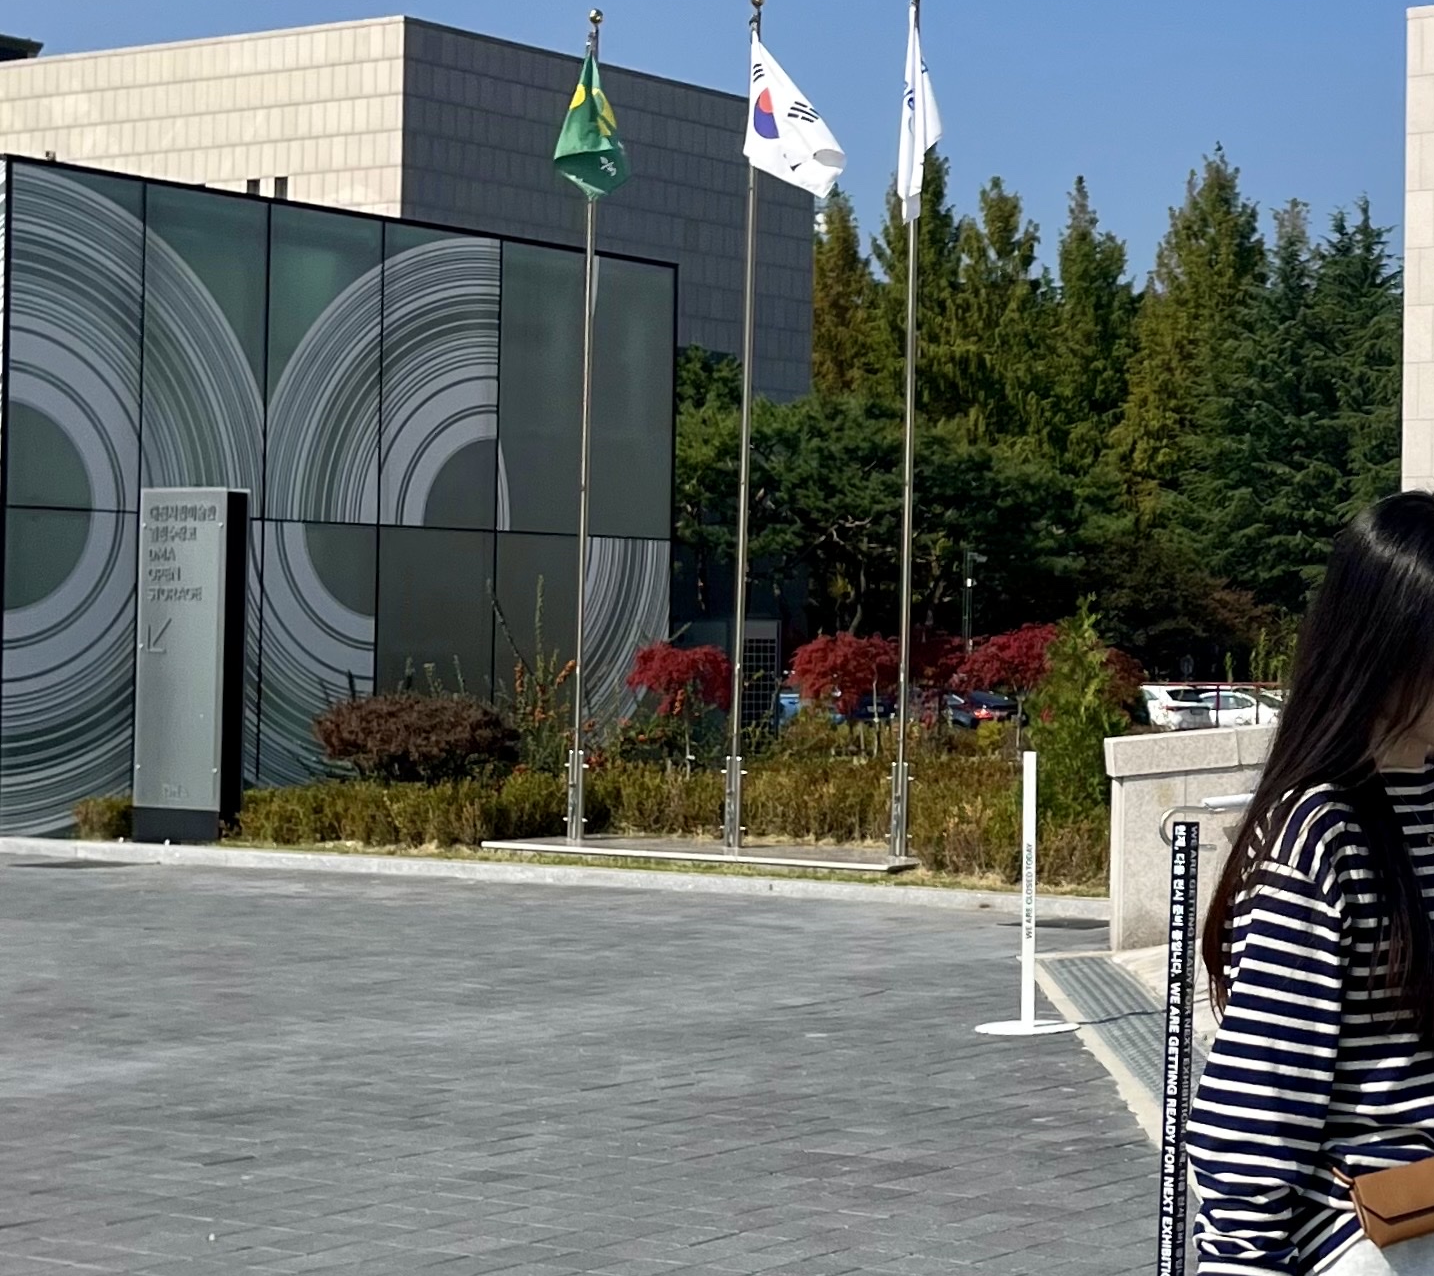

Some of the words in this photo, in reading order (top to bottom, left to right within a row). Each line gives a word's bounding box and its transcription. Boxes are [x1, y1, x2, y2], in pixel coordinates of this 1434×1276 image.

[1190, 825, 1198, 847] WE
[1026, 927, 1033, 940] WE
[1170, 982, 1182, 1005] WE
[1168, 1005, 1180, 1034] ARE
[1166, 1036, 1180, 1096] GETTING
[1165, 1098, 1177, 1143] READY
[1164, 1146, 1176, 1174] FOR
[1162, 1176, 1174, 1215] NEXT
